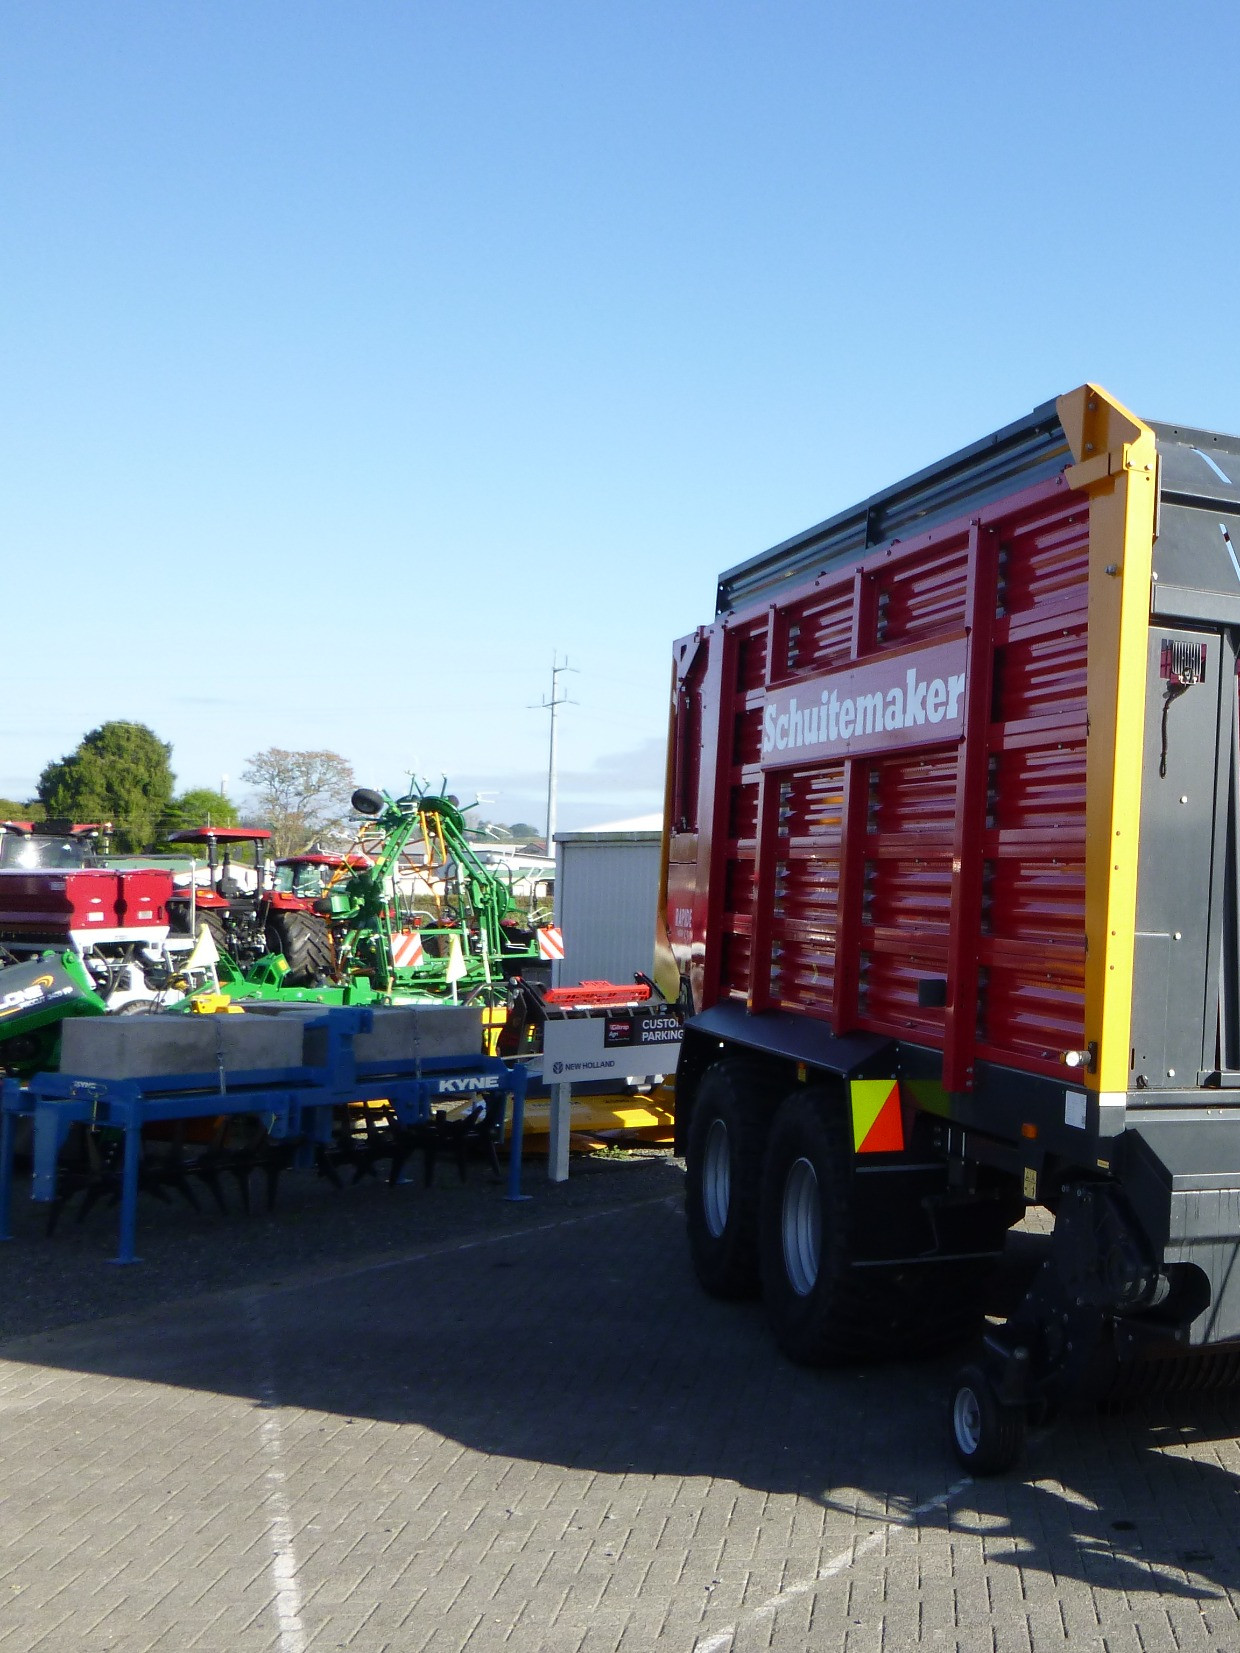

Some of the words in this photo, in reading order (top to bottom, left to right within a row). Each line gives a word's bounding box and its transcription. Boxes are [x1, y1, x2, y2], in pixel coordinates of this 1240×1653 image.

[763, 668, 966, 753] Schuitemaker
[642, 1030, 684, 1042] PARKING
[565, 1062, 581, 1071] NEW
[583, 1060, 615, 1070] HOLLAND
[439, 1076, 499, 1092] KYNE
